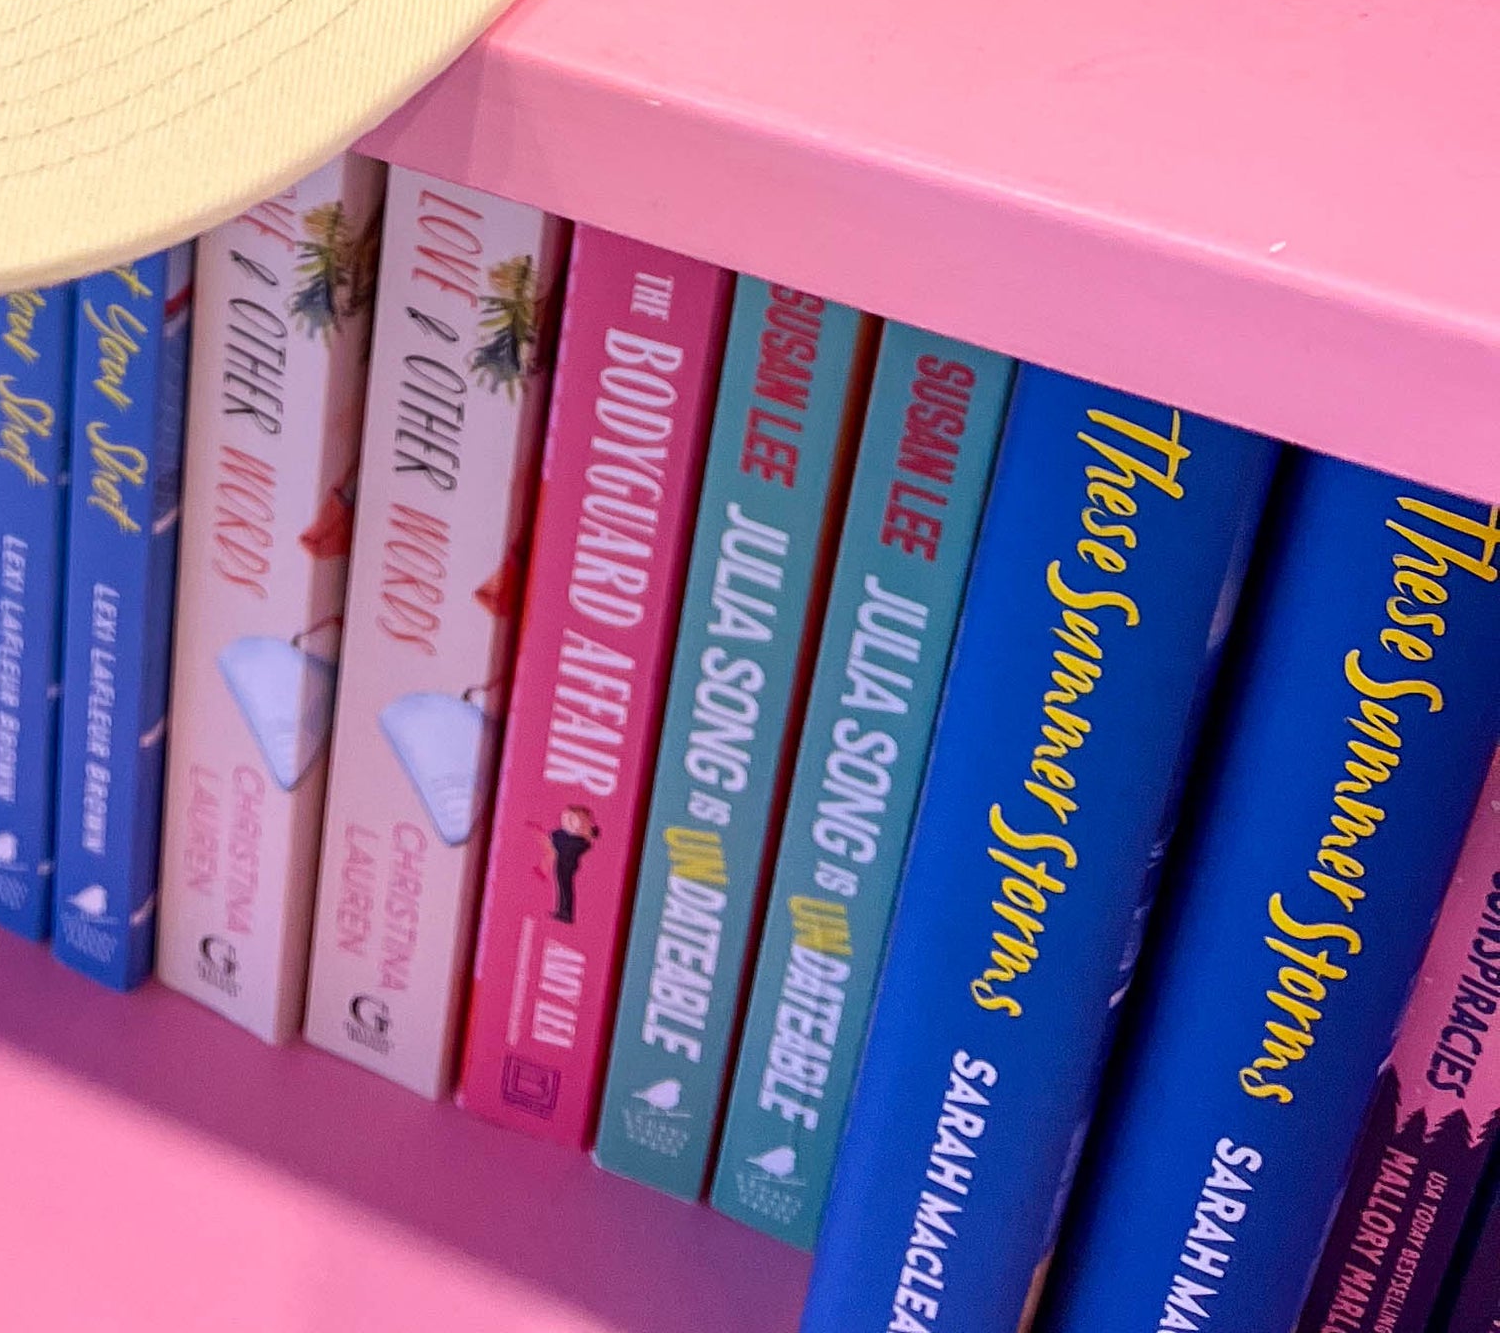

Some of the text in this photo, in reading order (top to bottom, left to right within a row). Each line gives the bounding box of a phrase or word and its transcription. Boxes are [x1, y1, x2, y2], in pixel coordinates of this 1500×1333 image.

[84, 299, 149, 412] Your
[223, 297, 289, 437] OTHER
[376, 189, 486, 658] LOVE OTHER WORDS
[740, 281, 826, 491] SUSAN LEE
[86, 421, 149, 534] Shot
[211, 445, 278, 601] WORDS
[878, 353, 977, 564] SUSAN LEE
[542, 271, 685, 797] THE BODYGUARD AFFAIR
[707, 500, 791, 645] JULIA
[92, 582, 121, 644] LEXI
[841, 573, 931, 716] JULIA
[684, 646, 766, 794] SONG
[969, 408, 1193, 1018] These Summer Storms
[225, 765, 266, 938] CHRISTINA
[686, 790, 733, 828] IS
[812, 716, 899, 865] SONG
[1237, 496, 1500, 1105] These Summer Storms
[336, 822, 379, 960] LAUREN
[382, 821, 429, 993] CHRISTINA
[641, 826, 730, 1063] UNDATEABLE
[812, 859, 860, 898] IS
[757, 894, 855, 1133] UNDATEABLE
[924, 1048, 999, 1196] SARAH
[1423, 1171, 1449, 1200] USA
[1180, 1136, 1264, 1279] SARAH
[1350, 1145, 1420, 1266] MALLORY
[1405, 1200, 1439, 1251] TODAY
